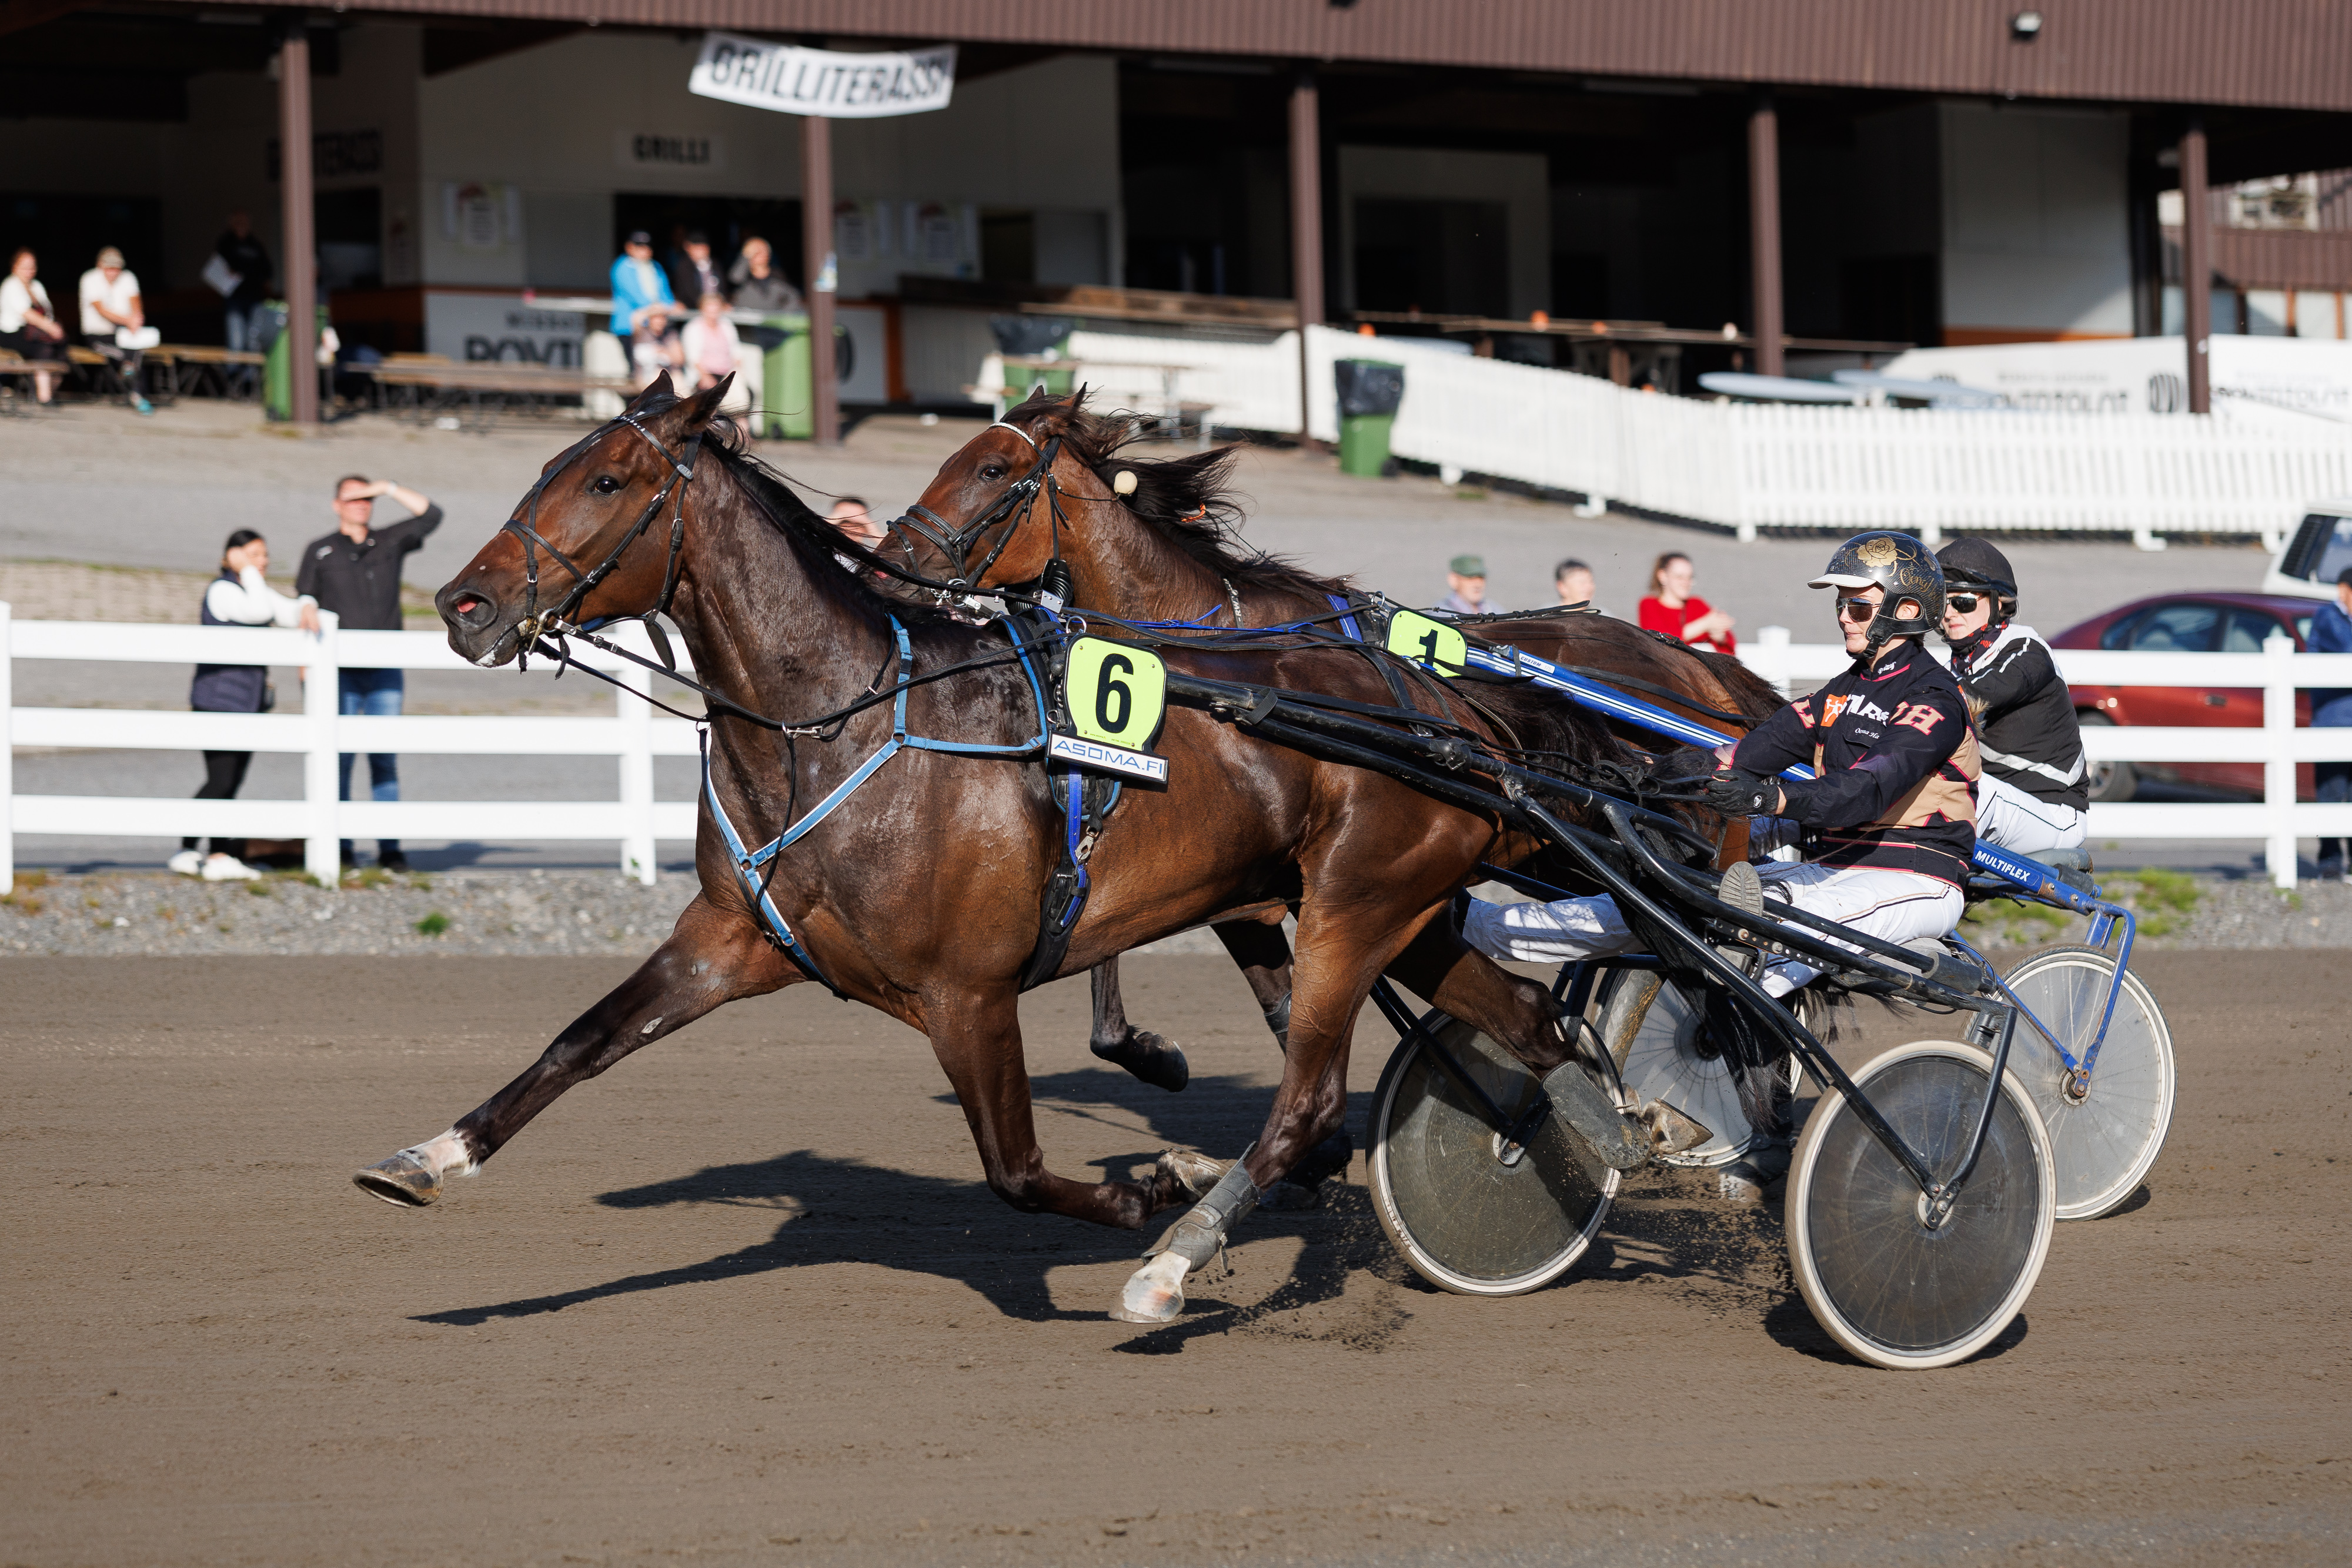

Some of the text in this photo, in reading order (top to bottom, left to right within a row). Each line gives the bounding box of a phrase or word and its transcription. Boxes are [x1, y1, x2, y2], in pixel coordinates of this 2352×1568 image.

[632, 134, 710, 165] GRILLI
[1419, 628, 1438, 667] 1
[1521, 656, 1541, 667] CUSTOM
[1095, 653, 1134, 734] 6
[1054, 740, 1162, 774] ASOMA.FI
[1975, 850, 2031, 882] MULTIFLEX
